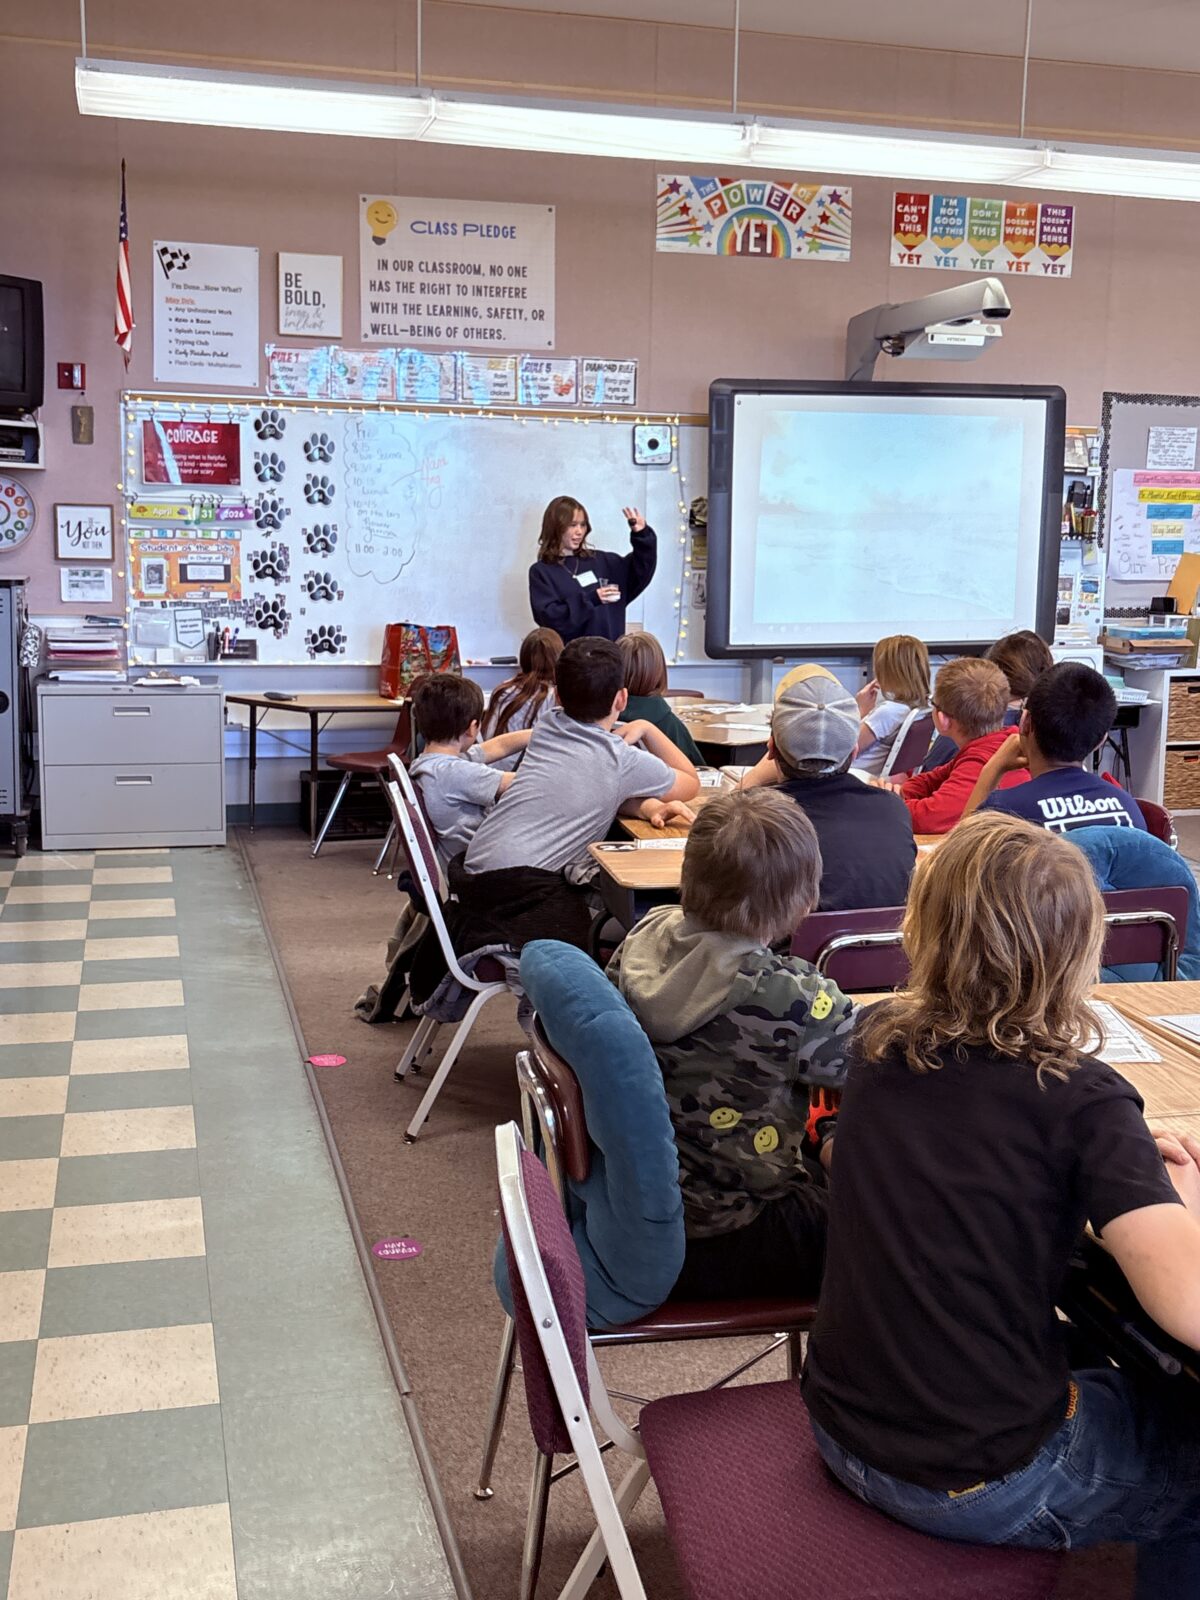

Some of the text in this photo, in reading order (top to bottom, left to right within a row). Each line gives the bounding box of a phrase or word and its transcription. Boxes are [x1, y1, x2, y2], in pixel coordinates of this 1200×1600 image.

[701, 182, 812, 220] THE POWER OF
[910, 196, 914, 204] I
[942, 198, 958, 207] I'M
[897, 205, 926, 214] CAN'T
[940, 207, 959, 216] NOT
[972, 210, 999, 218] DON'T
[1016, 208, 1026, 216] IT
[1047, 208, 1067, 216] THIS
[904, 214, 919, 222] DO
[934, 216, 963, 226] GOOD
[1006, 218, 1036, 226] DOESN'T
[1041, 217, 1070, 225] DOESN'T
[410, 221, 517, 239] CLASS PLEDGE
[900, 223, 922, 233] THIS
[945, 227, 964, 236] THIS
[972, 226, 997, 237] THIS
[1006, 227, 1035, 236] WORK
[1043, 226, 1068, 234] MAKE
[732, 217, 778, 254] YET
[1041, 235, 1068, 244] SENSE
[897, 253, 922, 265] YET
[934, 255, 958, 268] YET
[971, 258, 995, 270] YET
[377, 259, 528, 278] IN OUR CLASSROOM, NO ONE
[1006, 261, 1030, 273] YET
[1042, 263, 1066, 276] YET
[284, 272, 302, 288] BE
[220, 286, 242, 294] What?
[369, 280, 528, 299] HAS THE RIGHT TO INTERFERE
[284, 290, 326, 308] BOLD,
[370, 302, 545, 322] WITH THE LEARNING, SAFETY, OR
[446, 326, 459, 338] OF
[463, 328, 506, 341] OTHERS.
[174, 338, 195, 346] Typing
[546, 362, 552, 373] 5
[166, 428, 218, 444] COURAGE
[201, 510, 212, 518] 31
[223, 508, 244, 519] 2026
[8, 530, 12, 538] 5
[60, 520, 110, 547] You
[140, 544, 178, 552] Student
[182, 544, 192, 552] of
[194, 544, 210, 552] the
[1037, 794, 1124, 820] Wilson
